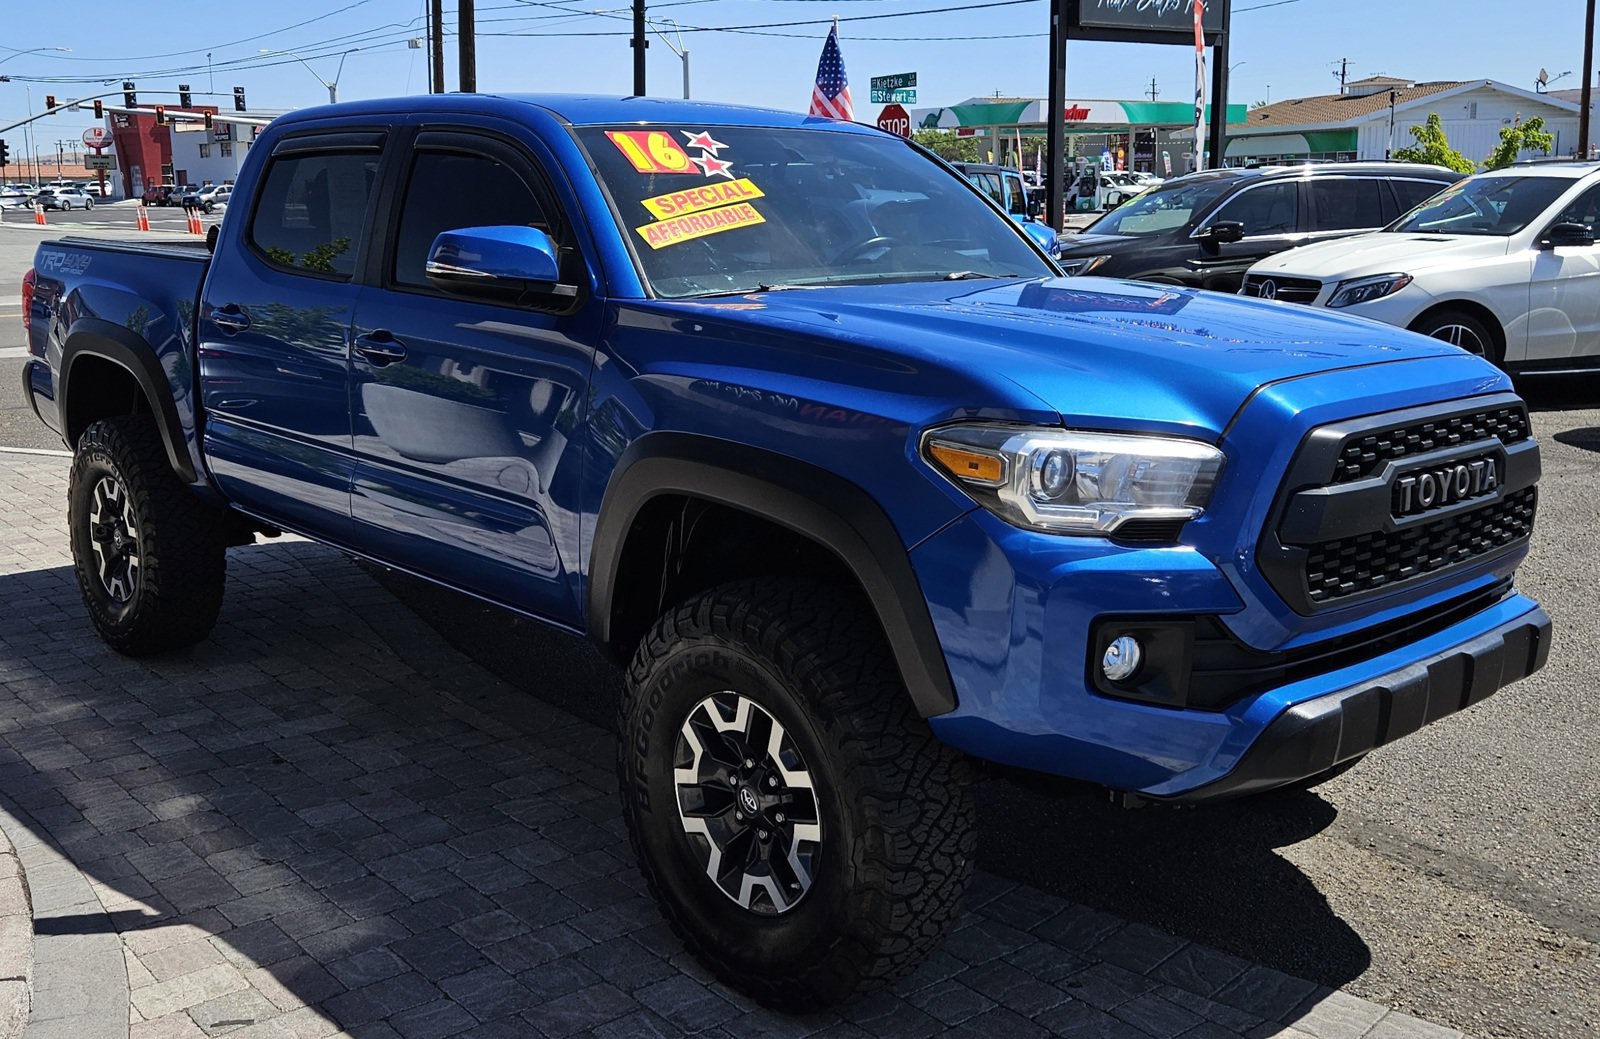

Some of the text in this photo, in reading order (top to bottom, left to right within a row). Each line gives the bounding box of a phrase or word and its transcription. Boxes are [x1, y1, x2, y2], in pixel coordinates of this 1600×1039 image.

[876, 76, 903, 89] Kietzke
[877, 90, 907, 103] Stewart
[880, 117, 908, 136] STOP
[612, 132, 690, 172] 16
[655, 180, 753, 215] SPECIAL
[645, 204, 756, 245] AFFORDABLE
[41, 250, 66, 271] TRD
[1395, 457, 1499, 513] TOYOTA
